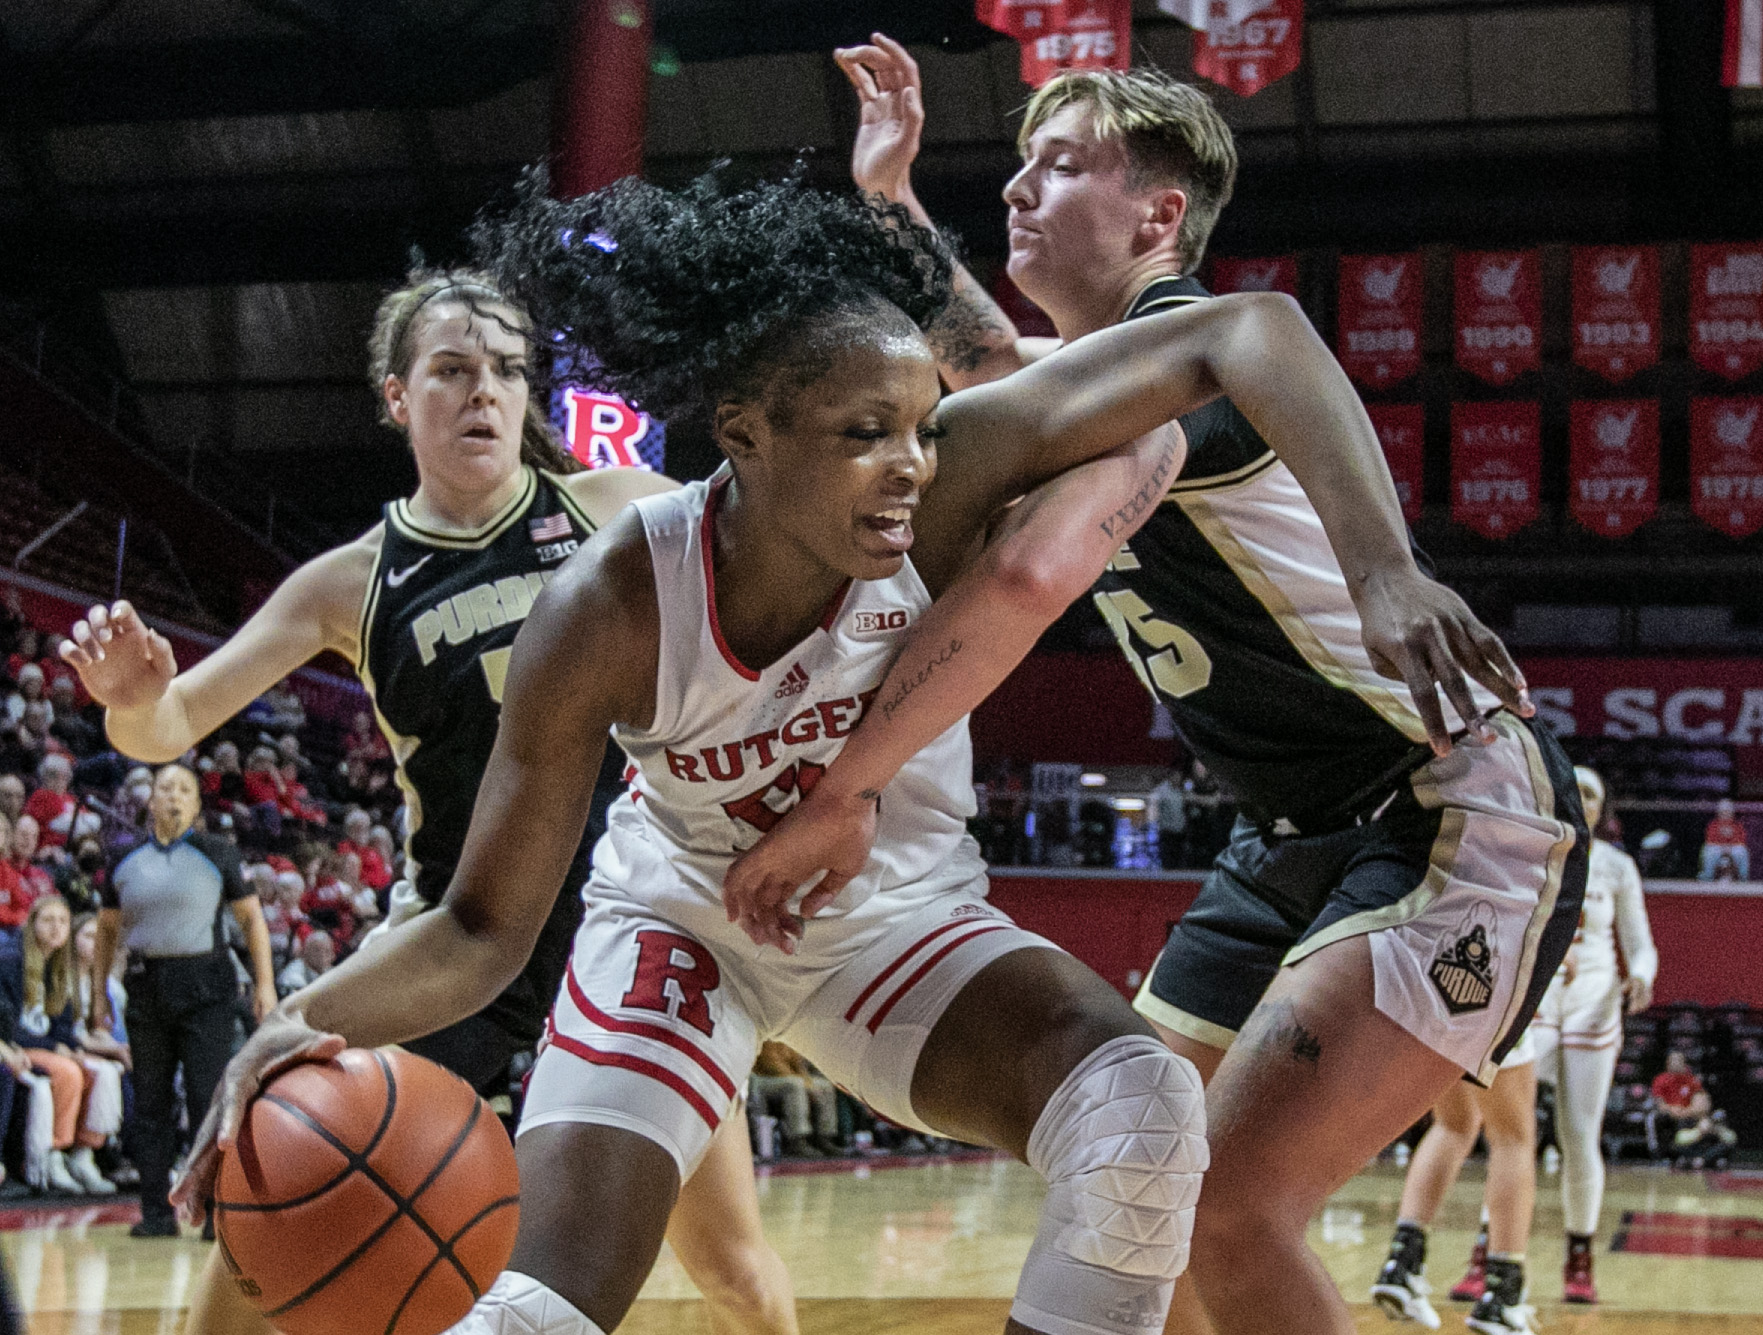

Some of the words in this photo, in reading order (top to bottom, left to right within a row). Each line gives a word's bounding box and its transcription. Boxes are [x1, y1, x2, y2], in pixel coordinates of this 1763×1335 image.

[564, 386, 650, 471] R
[881, 637, 963, 721] patience
[620, 929, 720, 1038] R
